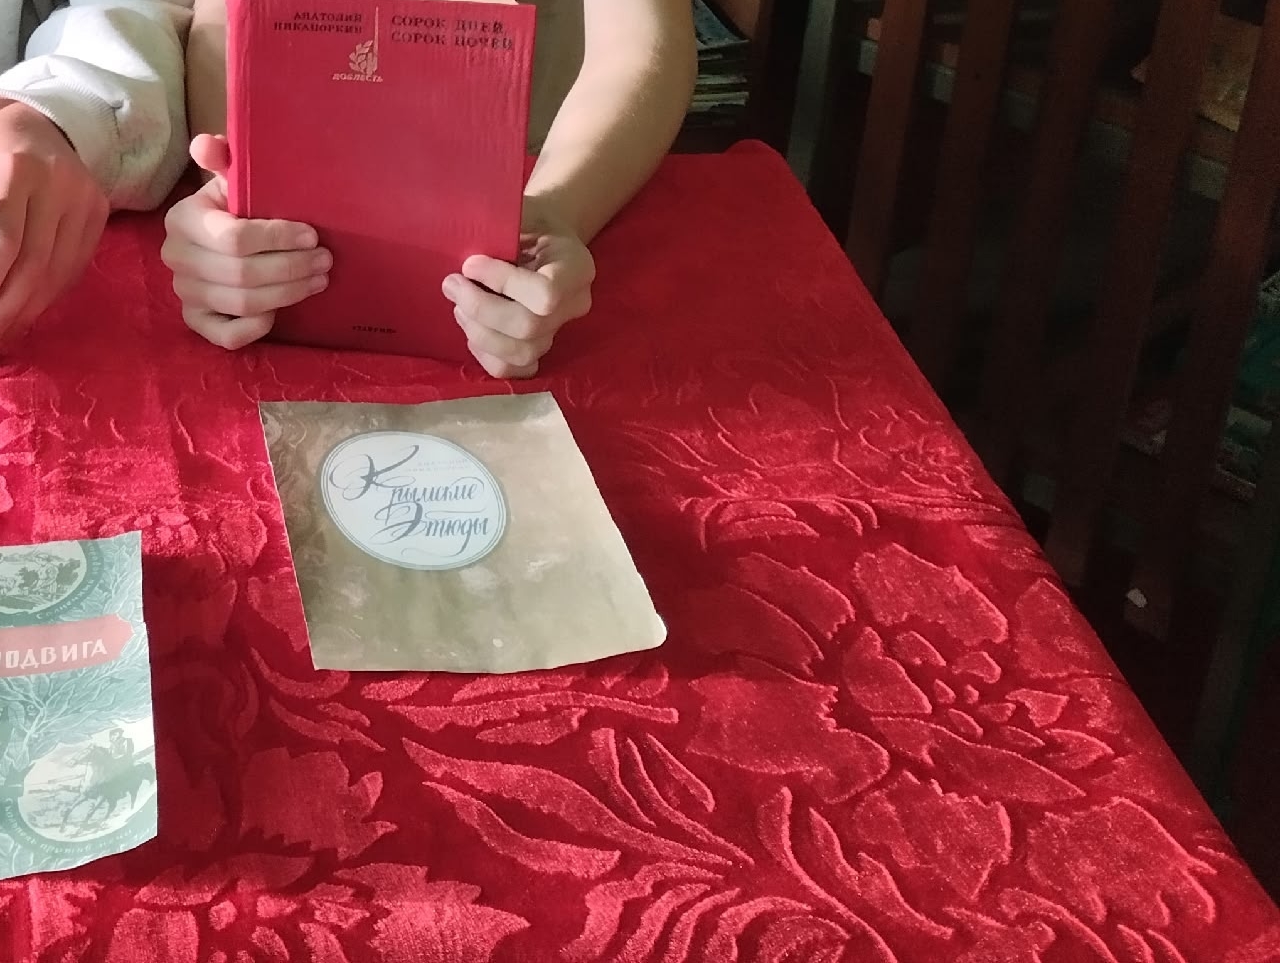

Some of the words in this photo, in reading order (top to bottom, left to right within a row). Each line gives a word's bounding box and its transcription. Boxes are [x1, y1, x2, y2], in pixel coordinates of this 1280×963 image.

[294, 11, 363, 22] АНАТОЛИЙ
[391, 15, 446, 29] СОРОК
[273, 22, 363, 33] НИКАНОРКИН
[391, 31, 446, 46] СОРОК
[454, 35, 515, 51] НОЧЕЙ
[332, 72, 384, 83] ДОБЛЕСТЬ
